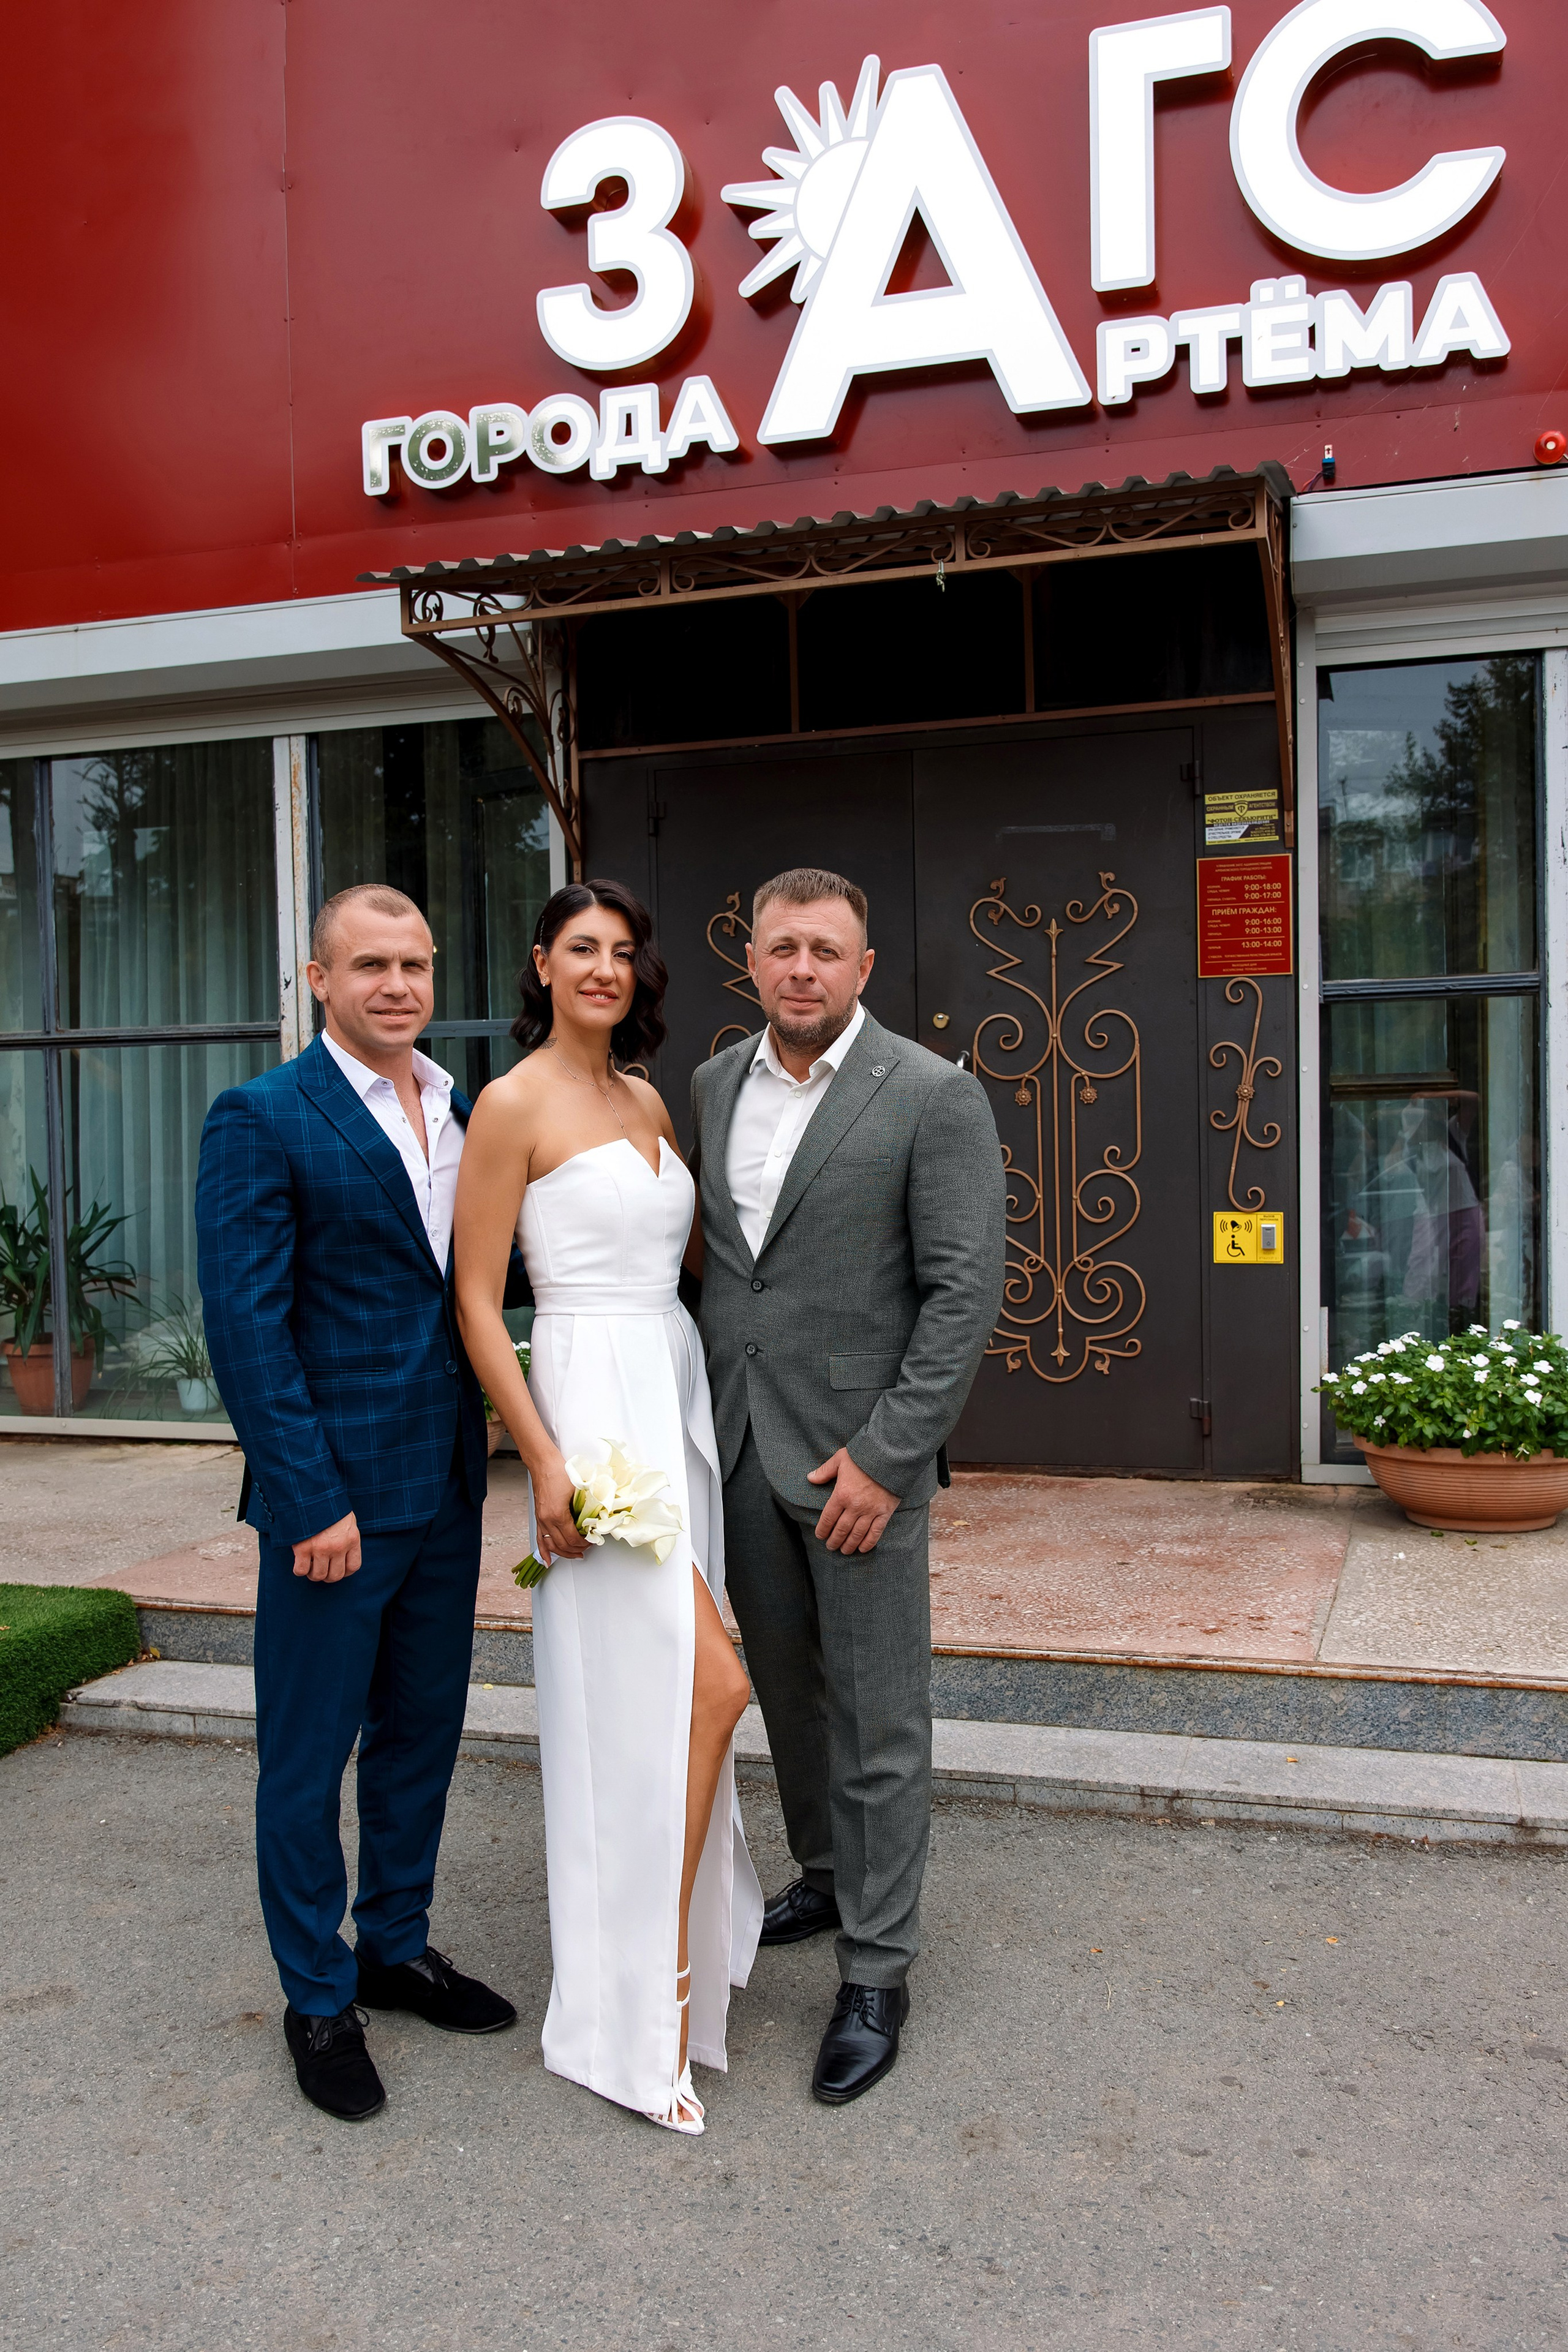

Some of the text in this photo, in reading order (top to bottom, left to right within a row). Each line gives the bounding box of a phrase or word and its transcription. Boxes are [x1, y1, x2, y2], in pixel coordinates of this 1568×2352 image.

[537, 0, 1507, 445] ЗАГС
[361, 375, 740, 497] ГОРОДА
[1212, 907, 1237, 916] ПРИЁМ
